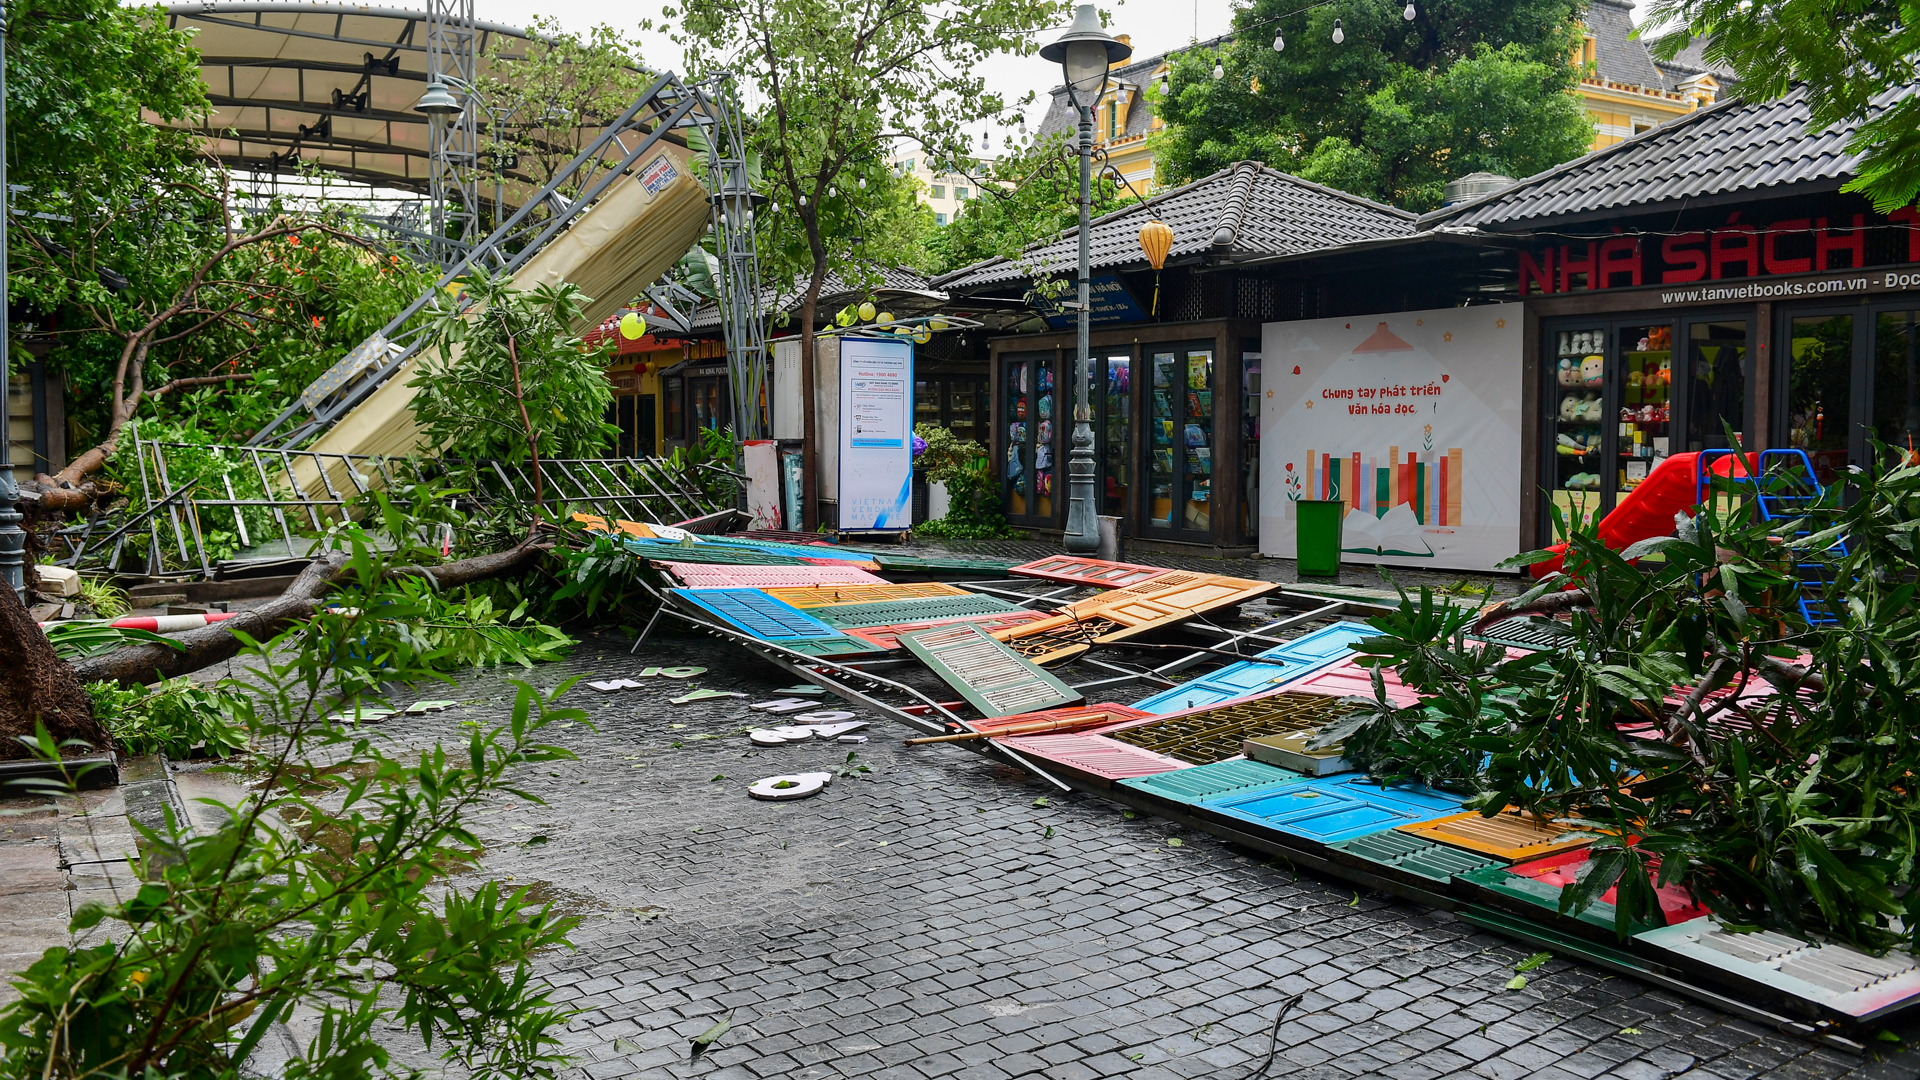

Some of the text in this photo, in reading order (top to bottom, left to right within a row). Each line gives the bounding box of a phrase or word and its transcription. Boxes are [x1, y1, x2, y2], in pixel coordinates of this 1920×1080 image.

[1519, 227, 1643, 296] NHÀ
[1661, 211, 1865, 285] SÁCH
[1322, 381, 1442, 400] Chung tay phát triển
[1348, 402, 1415, 416] Văn hóa đọc
[851, 498, 901, 506] VIETNAM
[851, 513, 901, 521] MACNE
